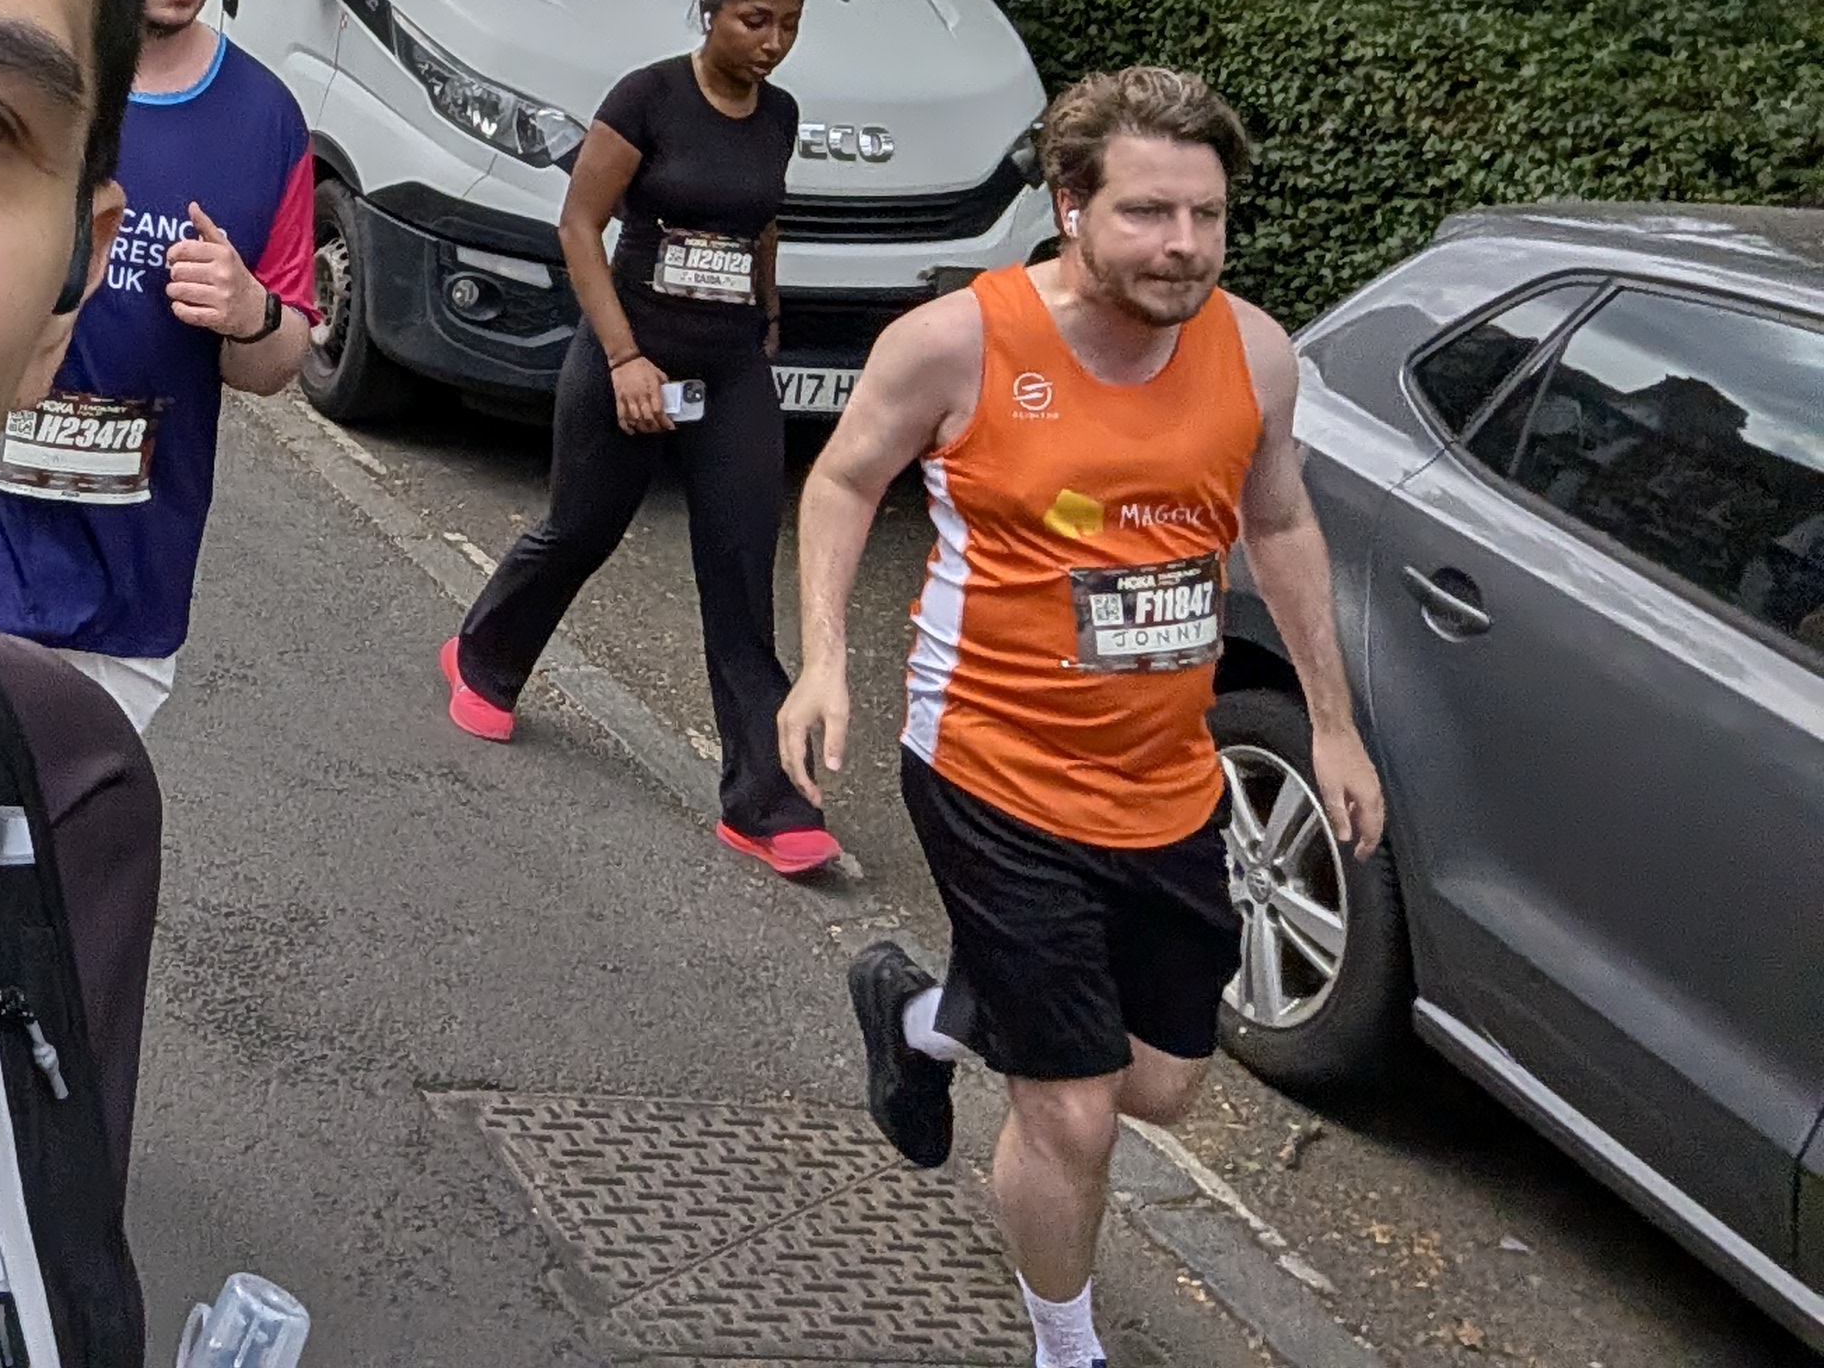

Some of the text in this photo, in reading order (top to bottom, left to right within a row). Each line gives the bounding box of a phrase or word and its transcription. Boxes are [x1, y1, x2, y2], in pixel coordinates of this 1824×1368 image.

[118, 209, 227, 242] CANC
[110, 237, 171, 268] RES
[107, 264, 146, 293] UK
[776, 372, 855, 406] Y17 H
[36, 413, 148, 450] H23478
[1135, 579, 1214, 625] F11847
[1112, 622, 1202, 648] JONNY
